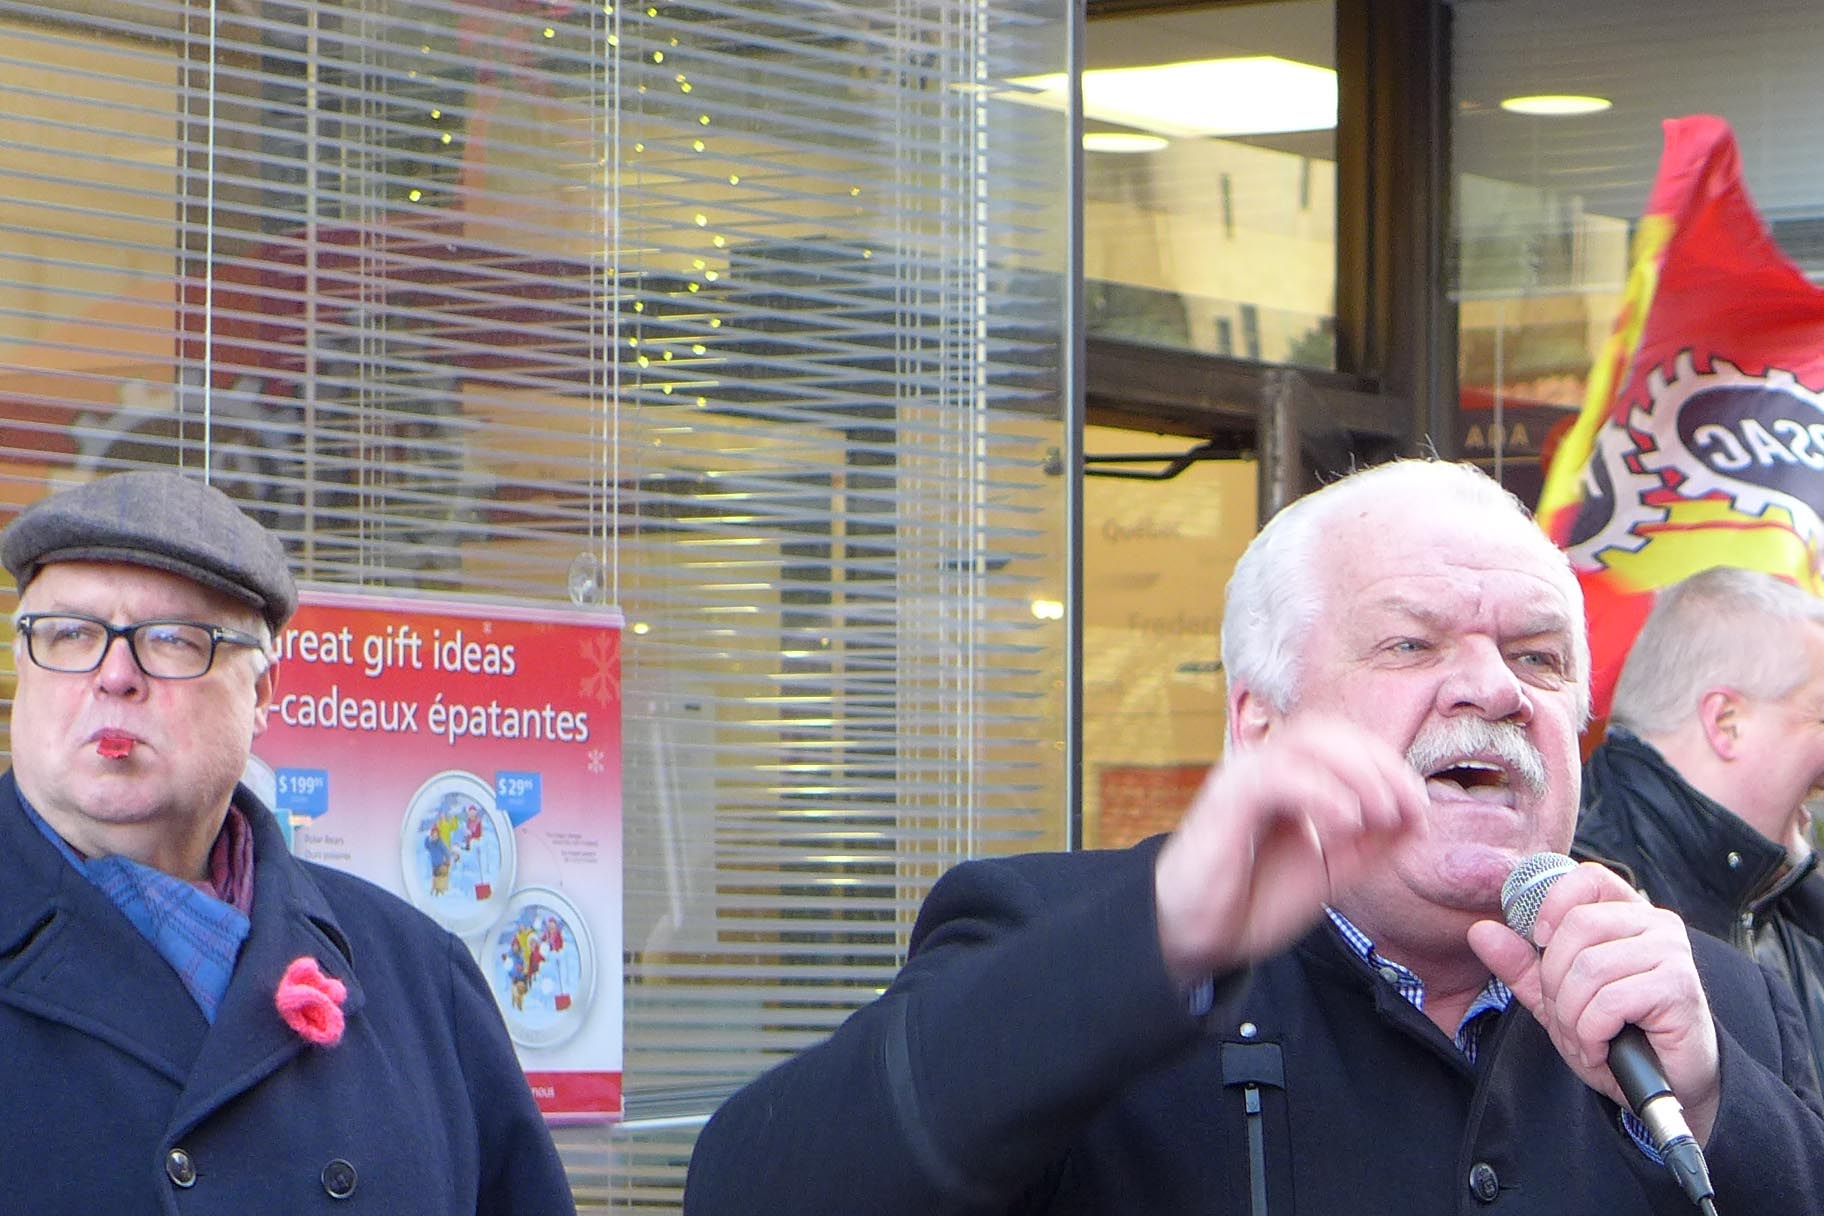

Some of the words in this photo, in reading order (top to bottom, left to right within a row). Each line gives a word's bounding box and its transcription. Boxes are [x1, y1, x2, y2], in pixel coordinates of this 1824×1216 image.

[362, 624, 423, 678] gift
[433, 629, 517, 677] ideas
[428, 691, 590, 744] épatantes
